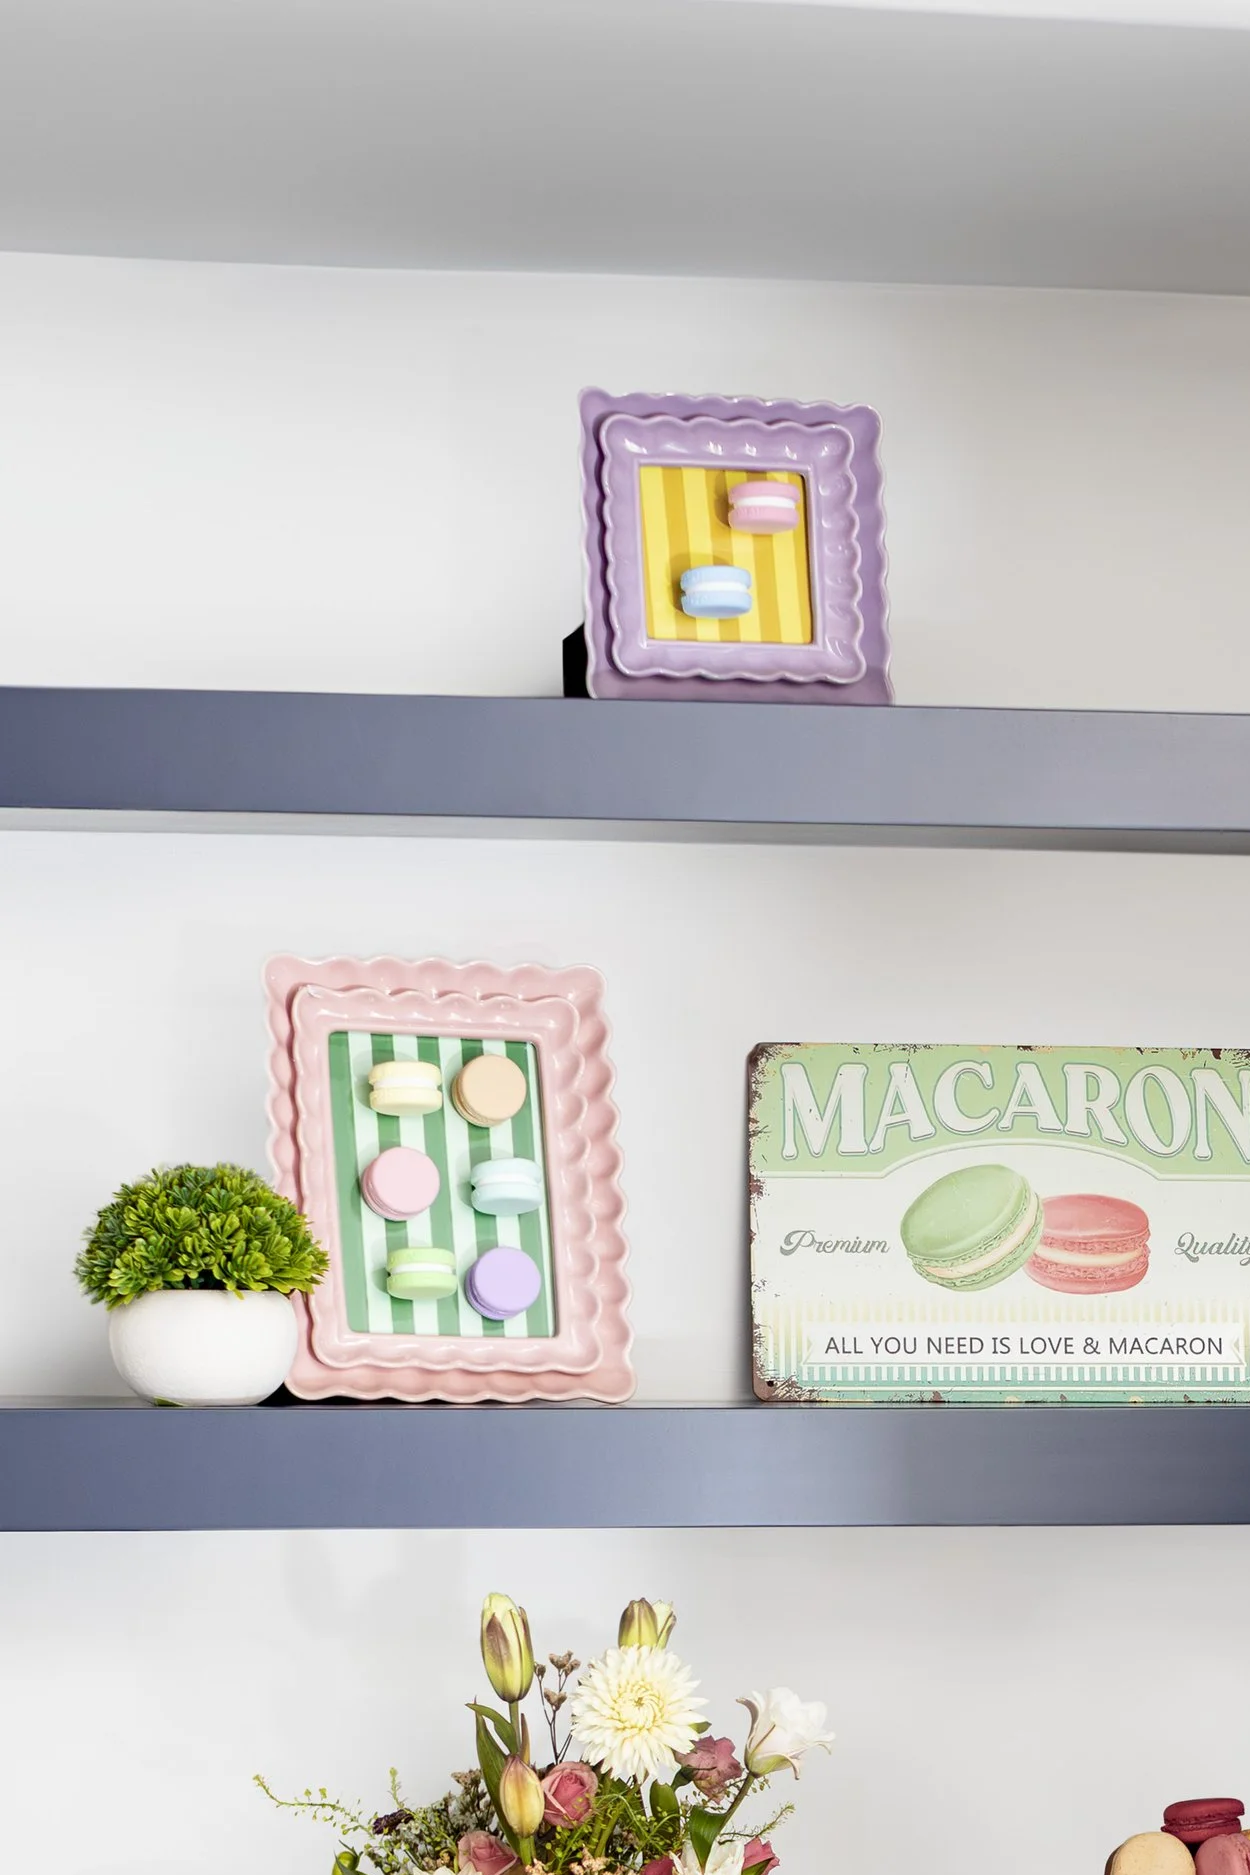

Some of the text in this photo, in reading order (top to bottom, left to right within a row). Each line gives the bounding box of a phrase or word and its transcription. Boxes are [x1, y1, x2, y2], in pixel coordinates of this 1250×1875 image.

[779, 1229, 890, 1257] Premium
[824, 1336, 1222, 1354] ALL YOU NEED IS LOVE & MACARON
